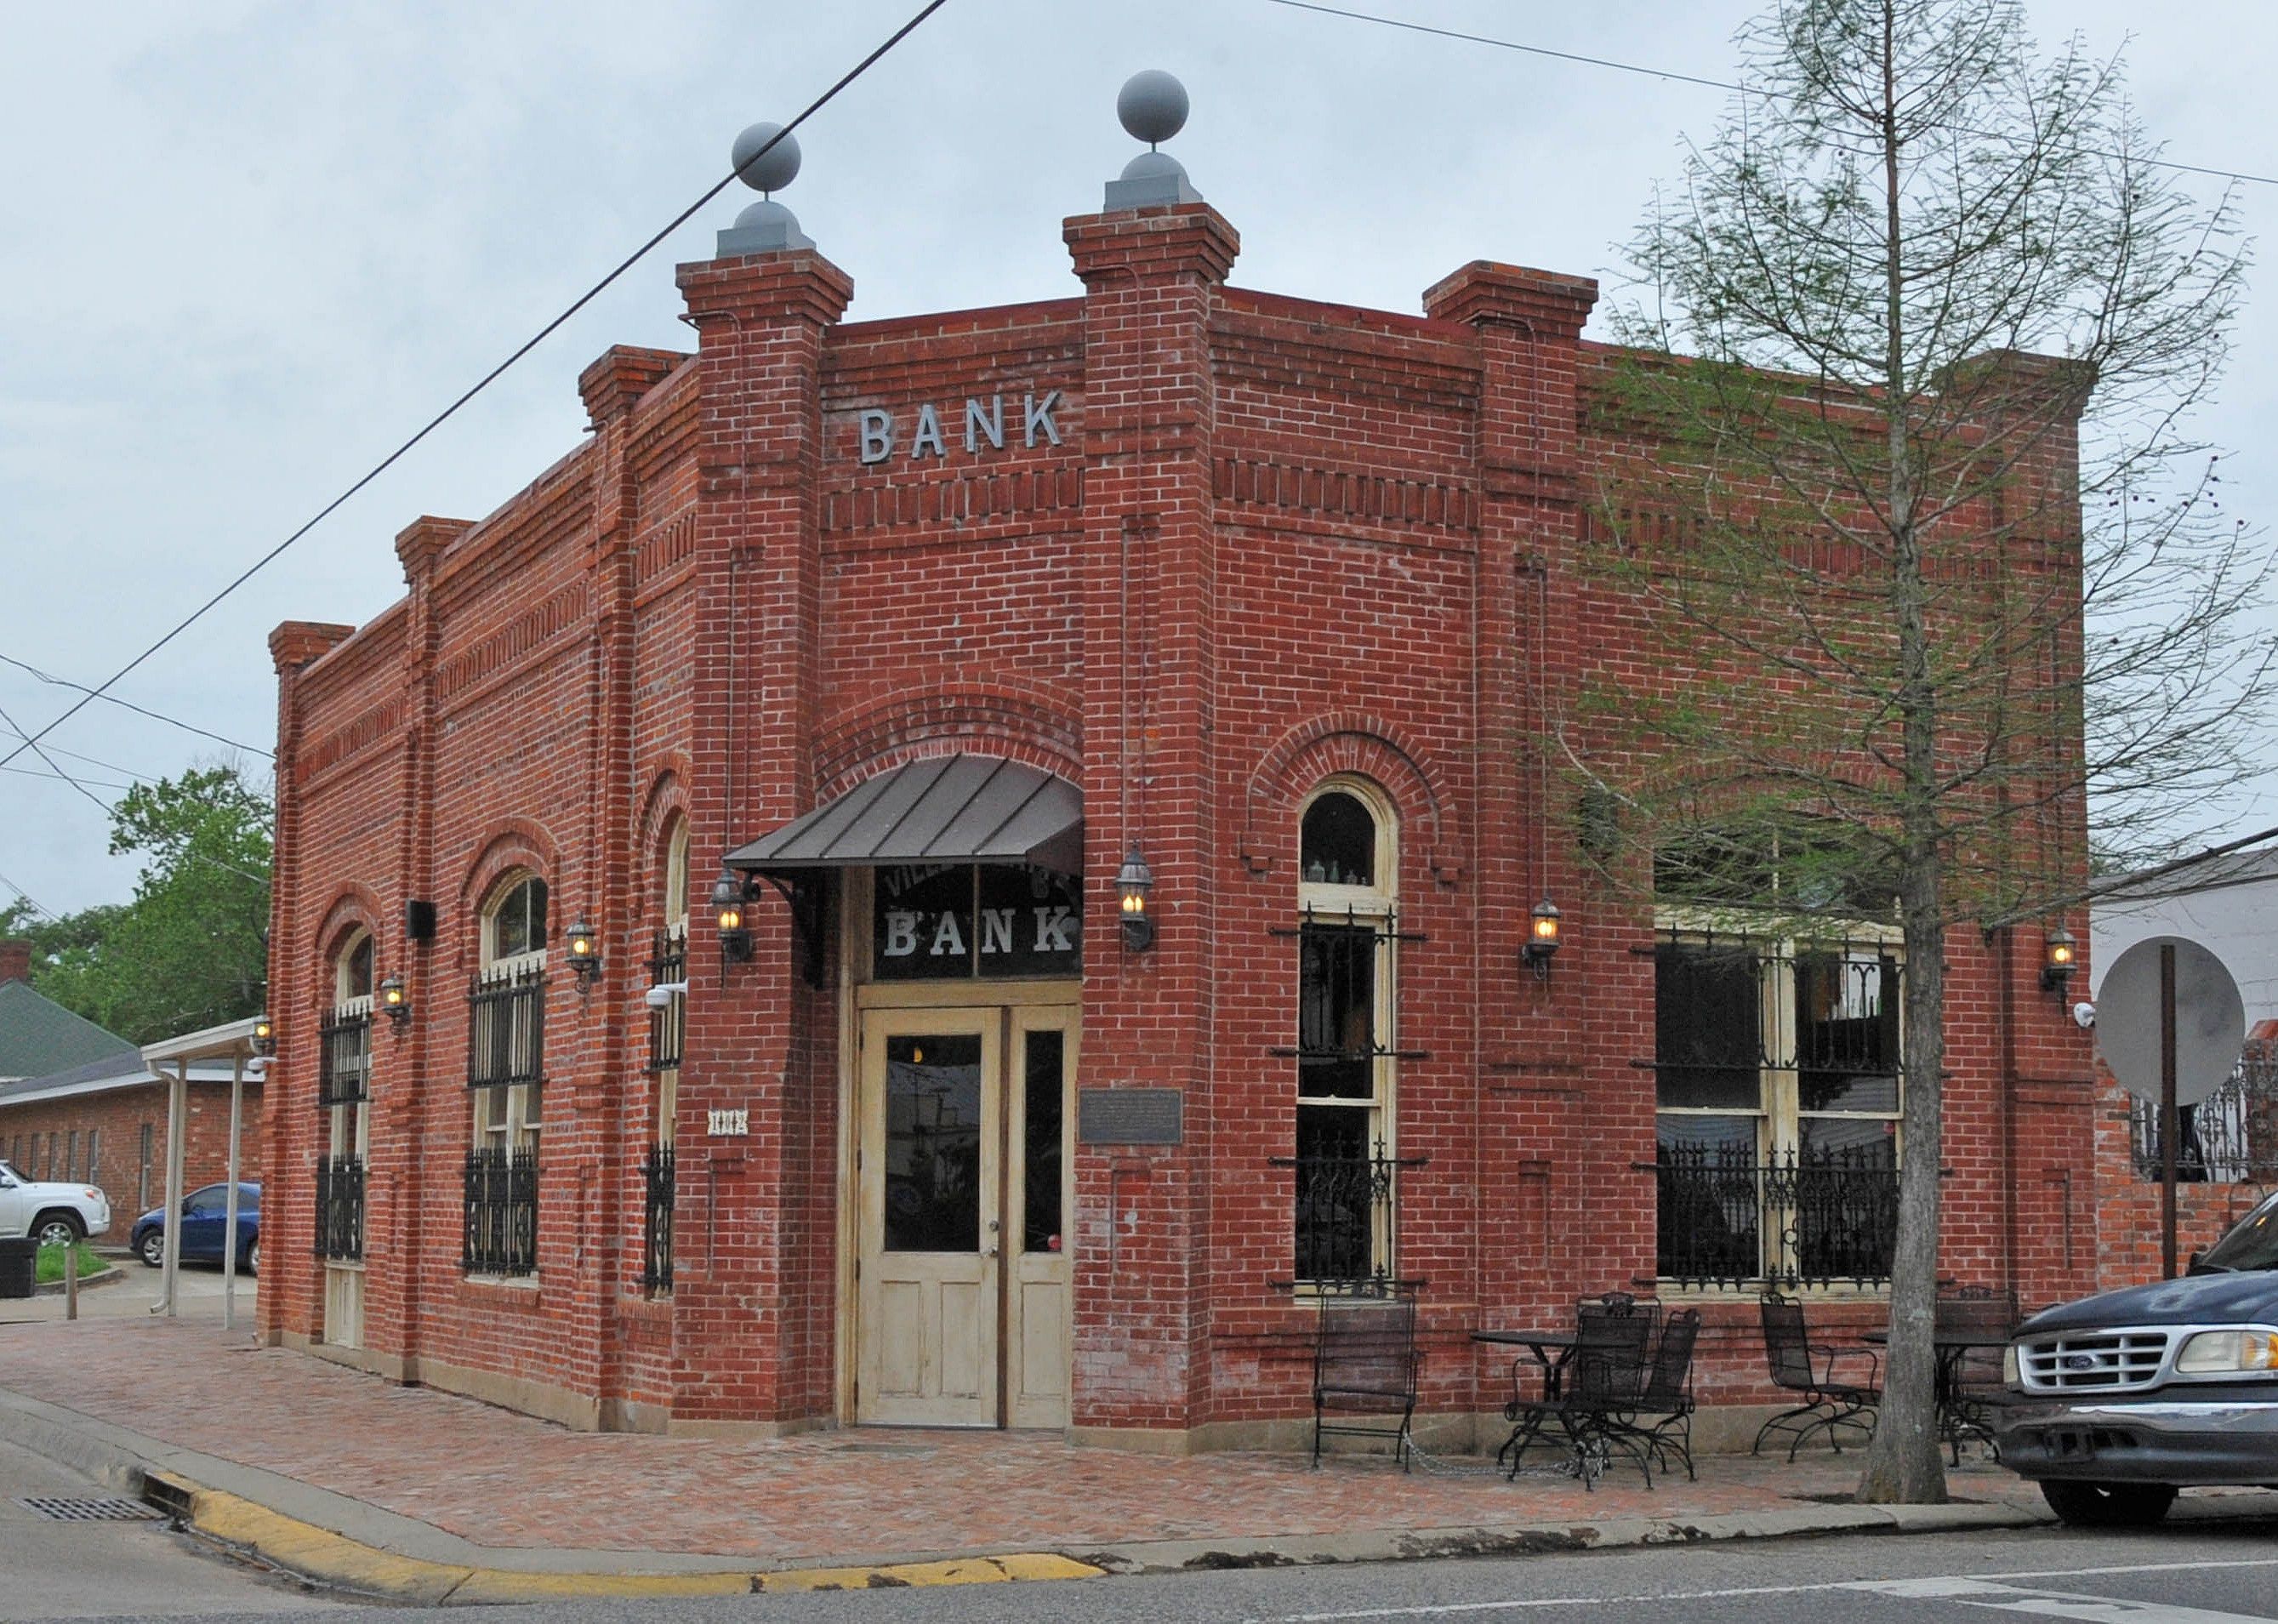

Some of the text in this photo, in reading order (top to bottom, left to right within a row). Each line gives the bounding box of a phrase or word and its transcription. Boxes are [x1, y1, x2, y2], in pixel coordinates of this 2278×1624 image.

[860, 391, 1062, 464] BANK
[883, 906, 1073, 956] BANK
[710, 1113, 746, 1132] 102
